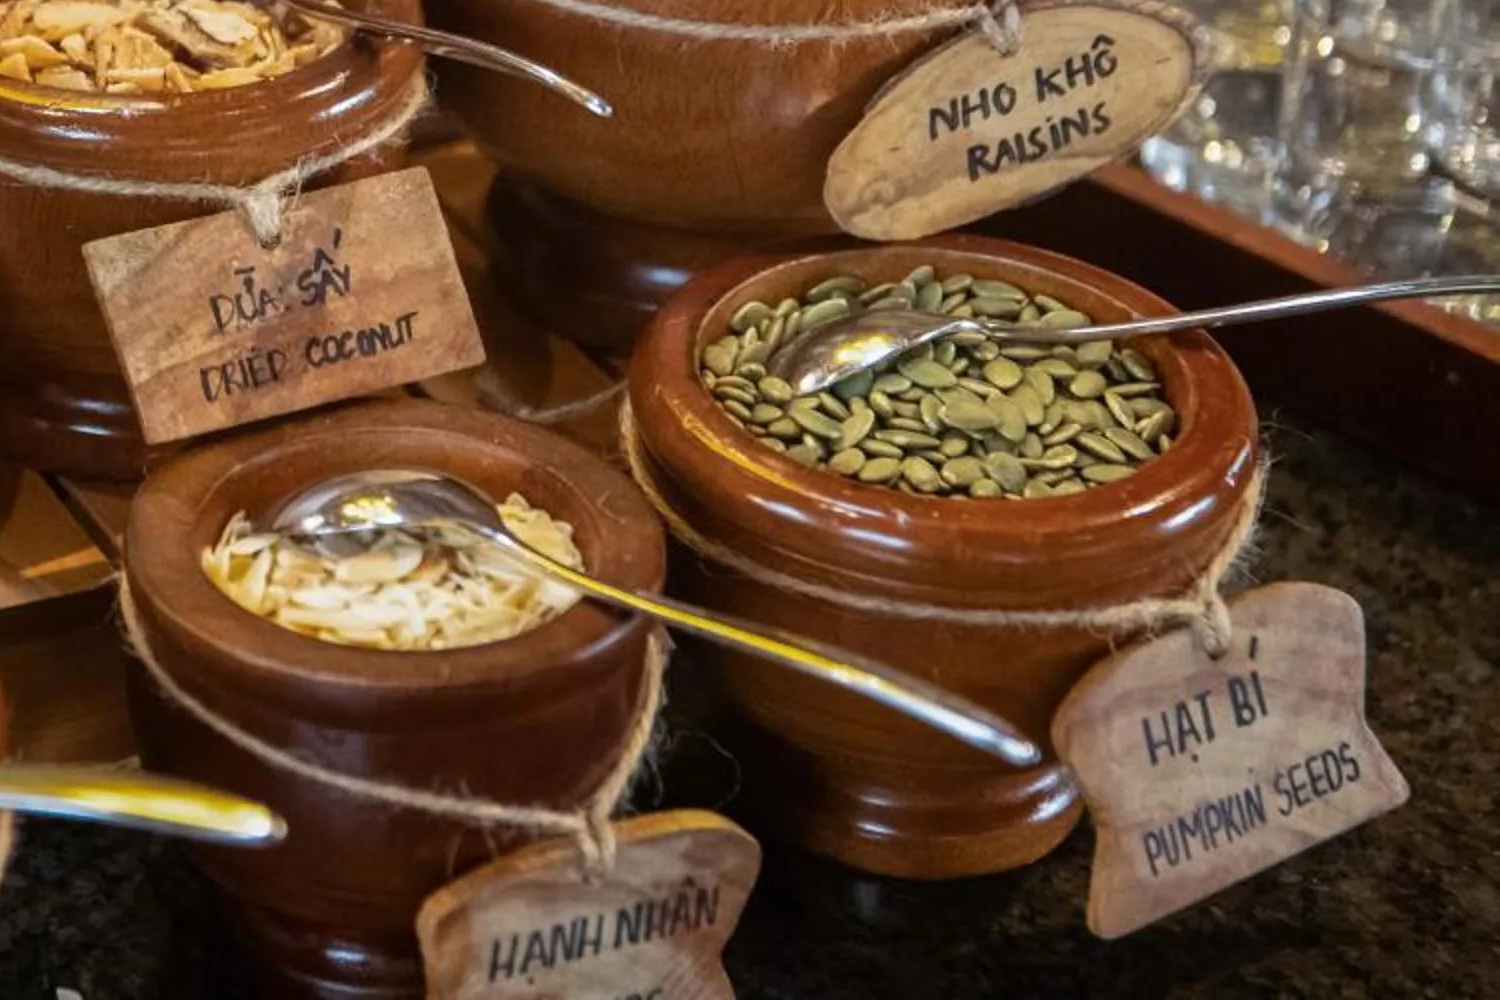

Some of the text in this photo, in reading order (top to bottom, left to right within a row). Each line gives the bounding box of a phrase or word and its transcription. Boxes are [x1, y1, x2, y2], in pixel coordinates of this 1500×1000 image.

[927, 33, 1119, 141] NHO KHÔ
[297, 227, 351, 307] SẤY
[200, 311, 420, 404] DRIED COCONUT
[1141, 635, 1269, 767] HẠT BÍ
[1142, 741, 1363, 878] PUMPKIN SEEDS
[488, 874, 721, 985] HẠNH NHÂN
